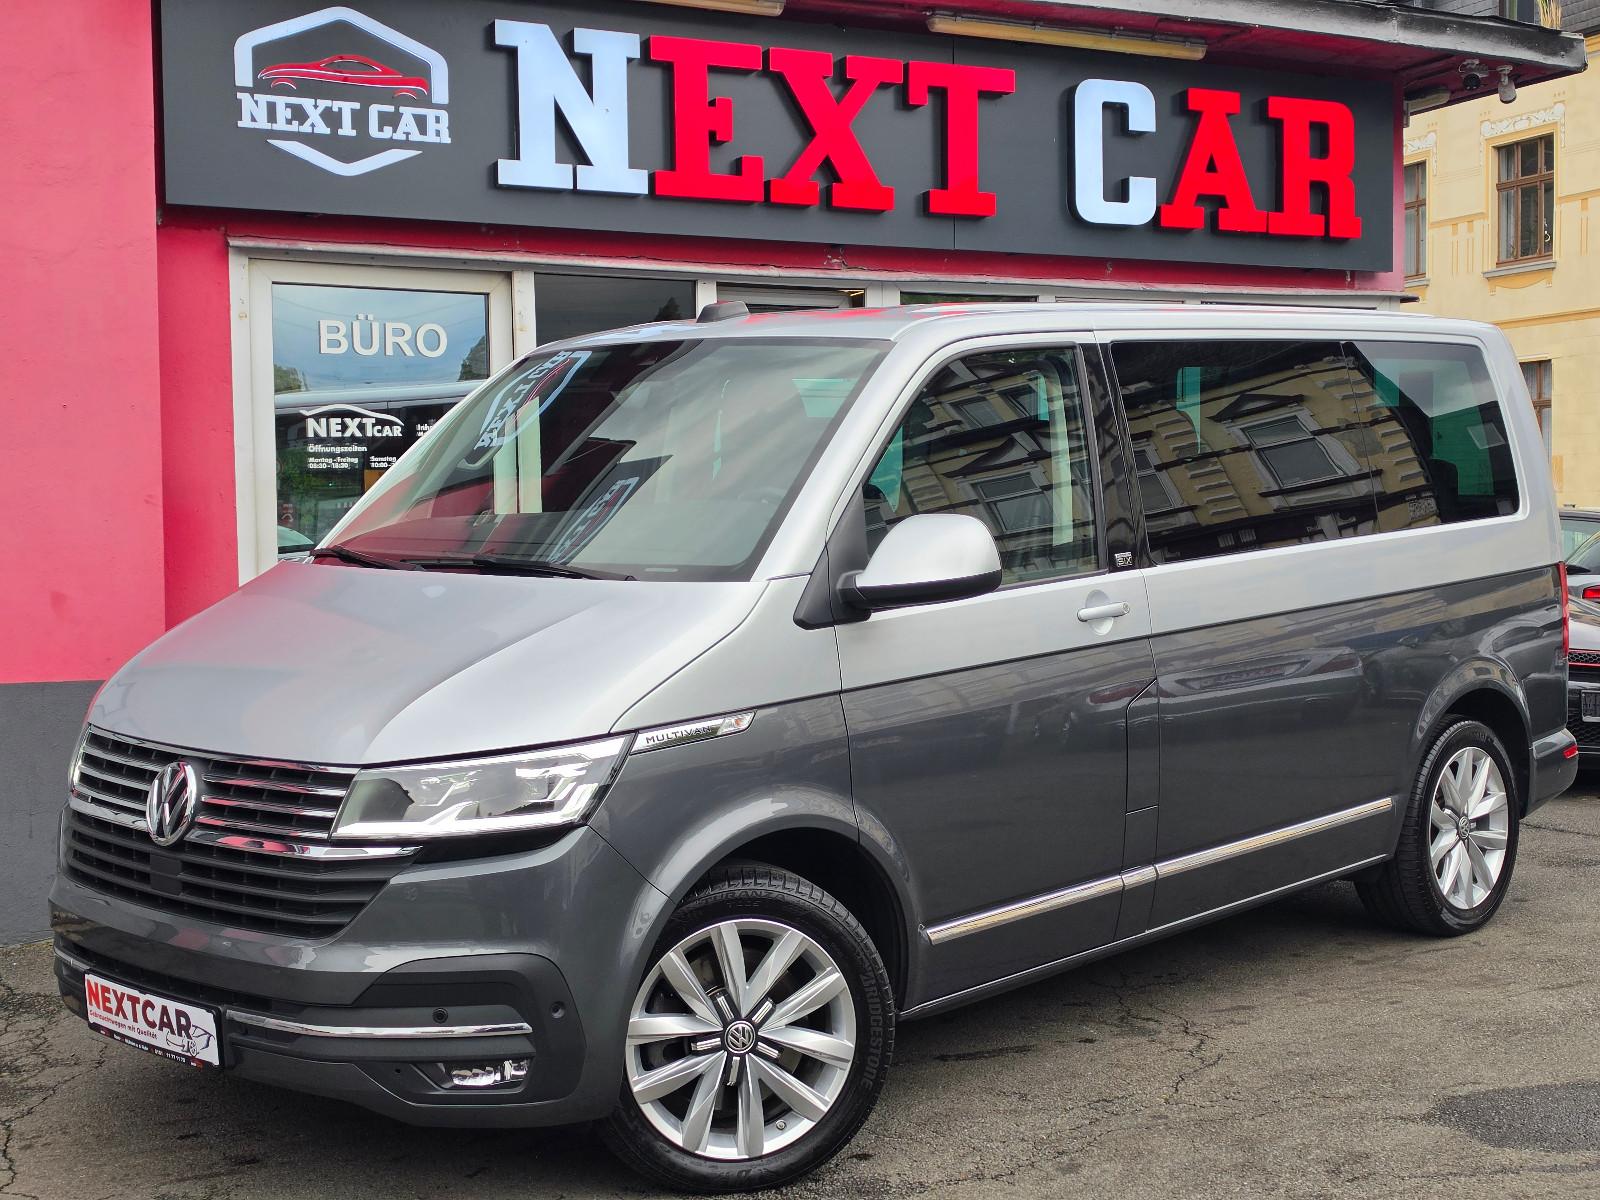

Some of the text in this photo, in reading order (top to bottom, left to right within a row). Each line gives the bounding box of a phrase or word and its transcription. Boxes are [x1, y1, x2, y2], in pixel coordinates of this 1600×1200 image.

[236, 92, 451, 144] NEXT CAR
[494, 18, 1362, 240] NEXT CAR
[318, 313, 449, 359] BÜRO
[645, 726, 712, 744] MULTIVAN
[86, 979, 193, 1041] NEXTCAR
